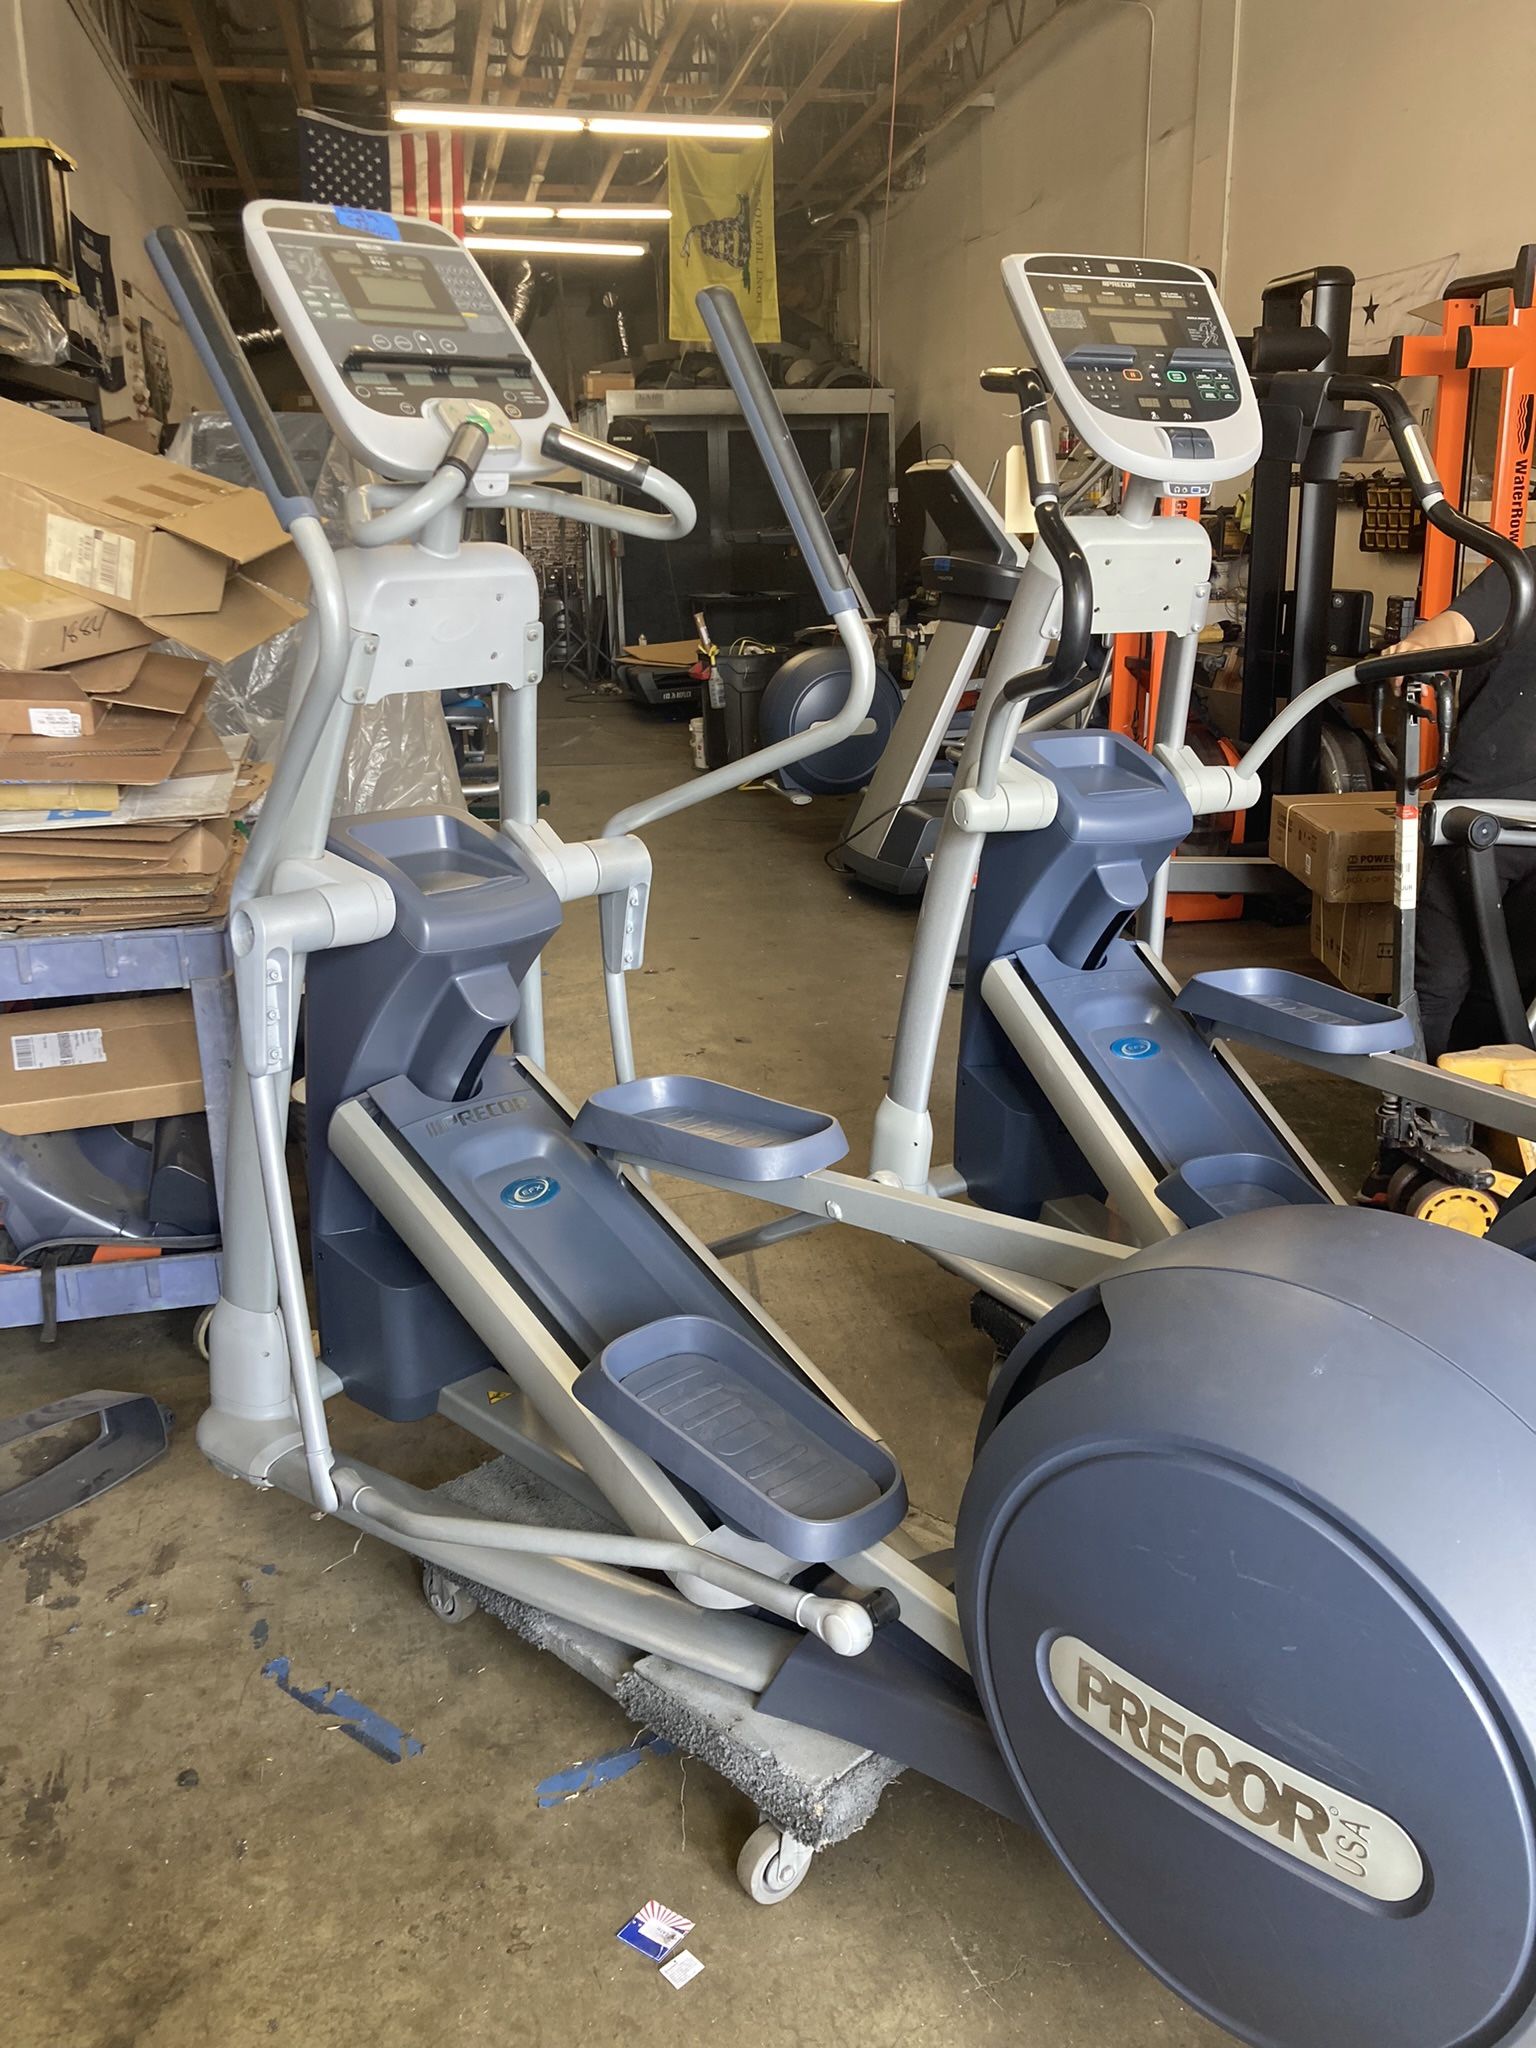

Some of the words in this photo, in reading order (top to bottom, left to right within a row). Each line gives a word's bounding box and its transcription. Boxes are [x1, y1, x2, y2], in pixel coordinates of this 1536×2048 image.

[755, 219, 763, 263] TREAD
[442, 1097, 530, 1131] PRECOR
[521, 1184, 543, 1196] EFX
[1076, 1656, 1333, 1861] PRECOR
[1334, 1814, 1371, 1878] USA
